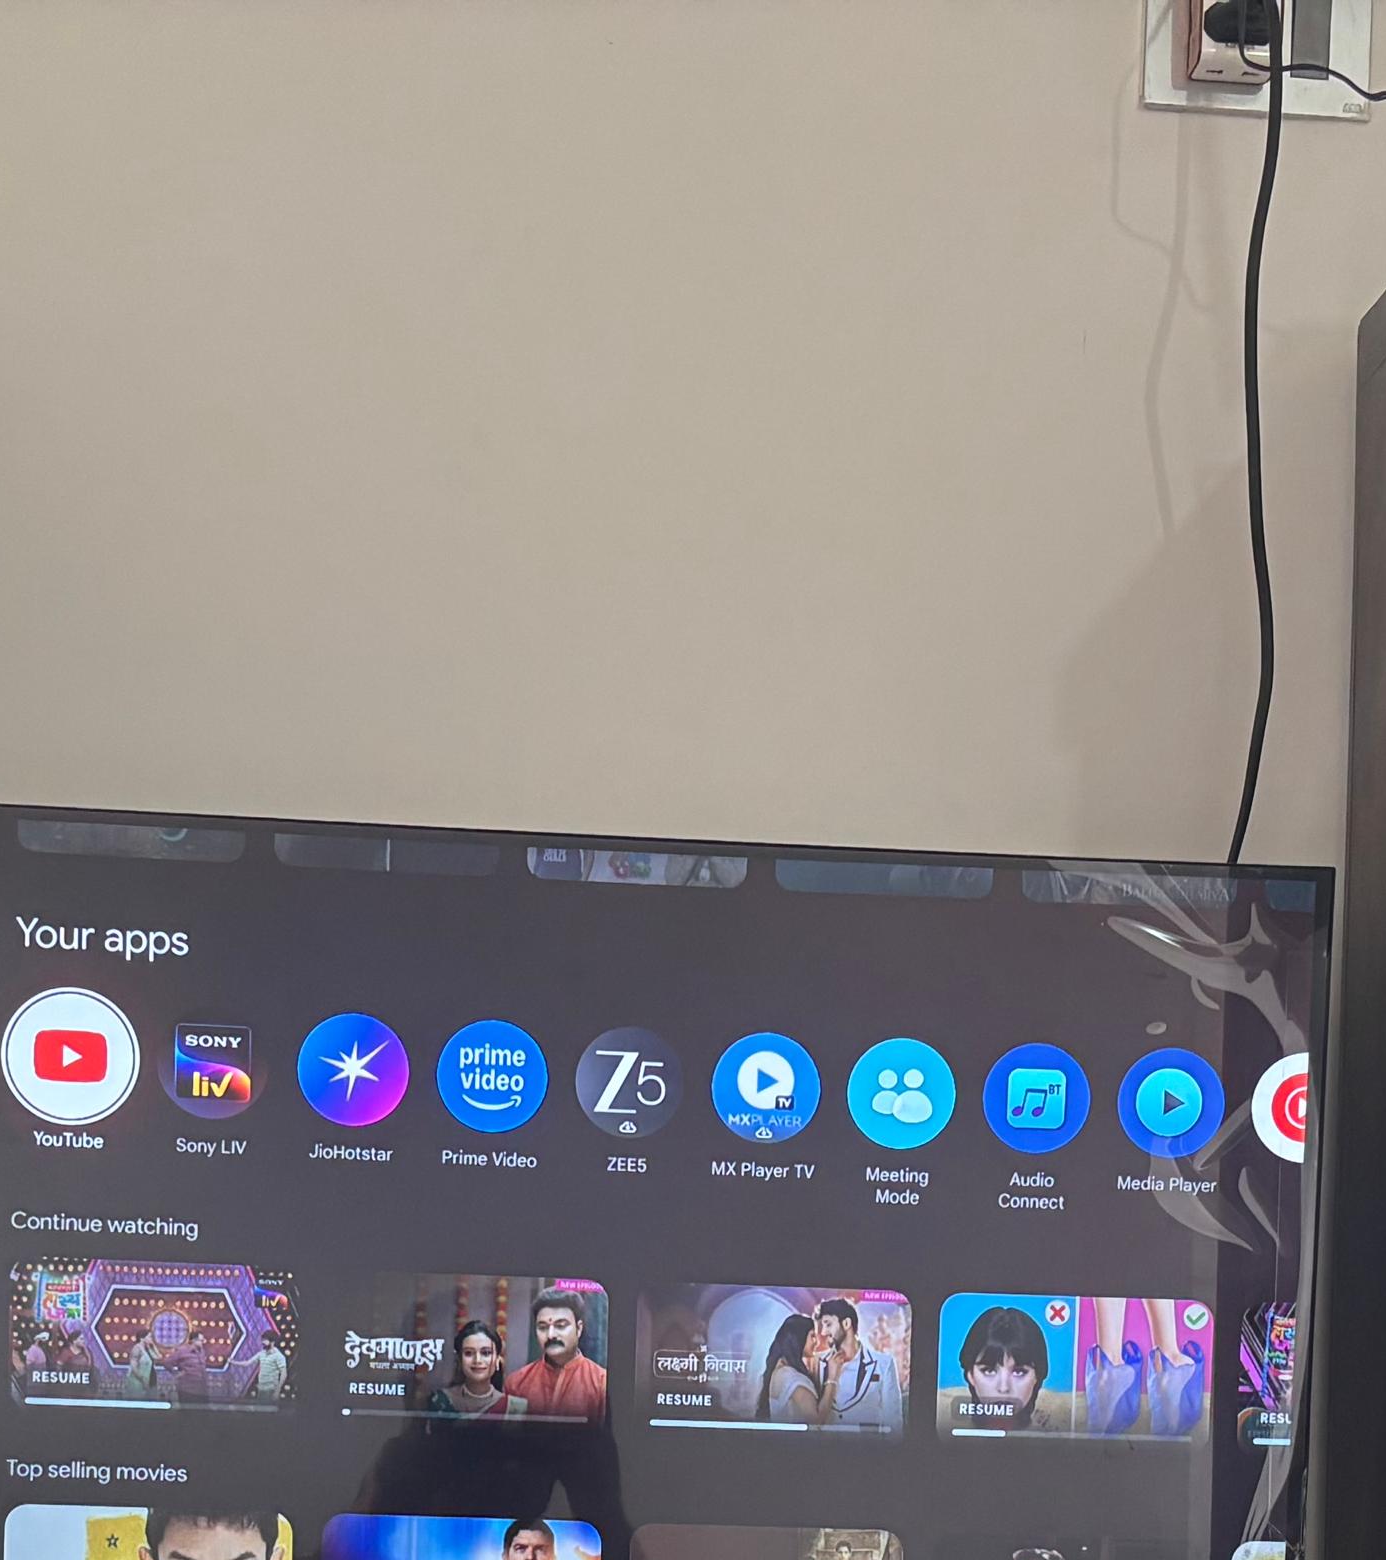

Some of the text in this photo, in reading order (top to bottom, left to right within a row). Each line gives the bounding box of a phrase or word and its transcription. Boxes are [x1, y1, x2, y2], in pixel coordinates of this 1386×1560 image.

[16, 916, 190, 962] Your apps
[185, 1034, 242, 1049] SONY
[459, 1043, 527, 1069] prime
[192, 1071, 234, 1098] liv
[460, 1068, 525, 1092] video
[1048, 1083, 1062, 1096] BT
[776, 1097, 793, 1109] TV
[33, 1130, 104, 1150] YouTube
[175, 1138, 247, 1158] Sony LIV
[309, 1143, 393, 1162] JioHotstar
[441, 1149, 538, 1169] Prime Video
[606, 1156, 648, 1174] ZEE5
[711, 1161, 815, 1182] MX Player TV
[865, 1166, 929, 1187] Meeting
[1009, 1172, 1055, 1188] Audio
[1116, 1175, 1217, 1195] Media Player
[875, 1188, 920, 1206] Mode
[998, 1192, 1065, 1211] Connect
[10, 1211, 200, 1241] Continue watching
[344, 1330, 445, 1372] देवमाणूस
[703, 1354, 748, 1374] निवास
[32, 1370, 90, 1385] RESUME
[349, 1382, 406, 1396] RESUME
[657, 1393, 712, 1406] RESUME
[959, 1403, 1014, 1417] RESUME
[6, 1459, 188, 1484] Top selling movies
